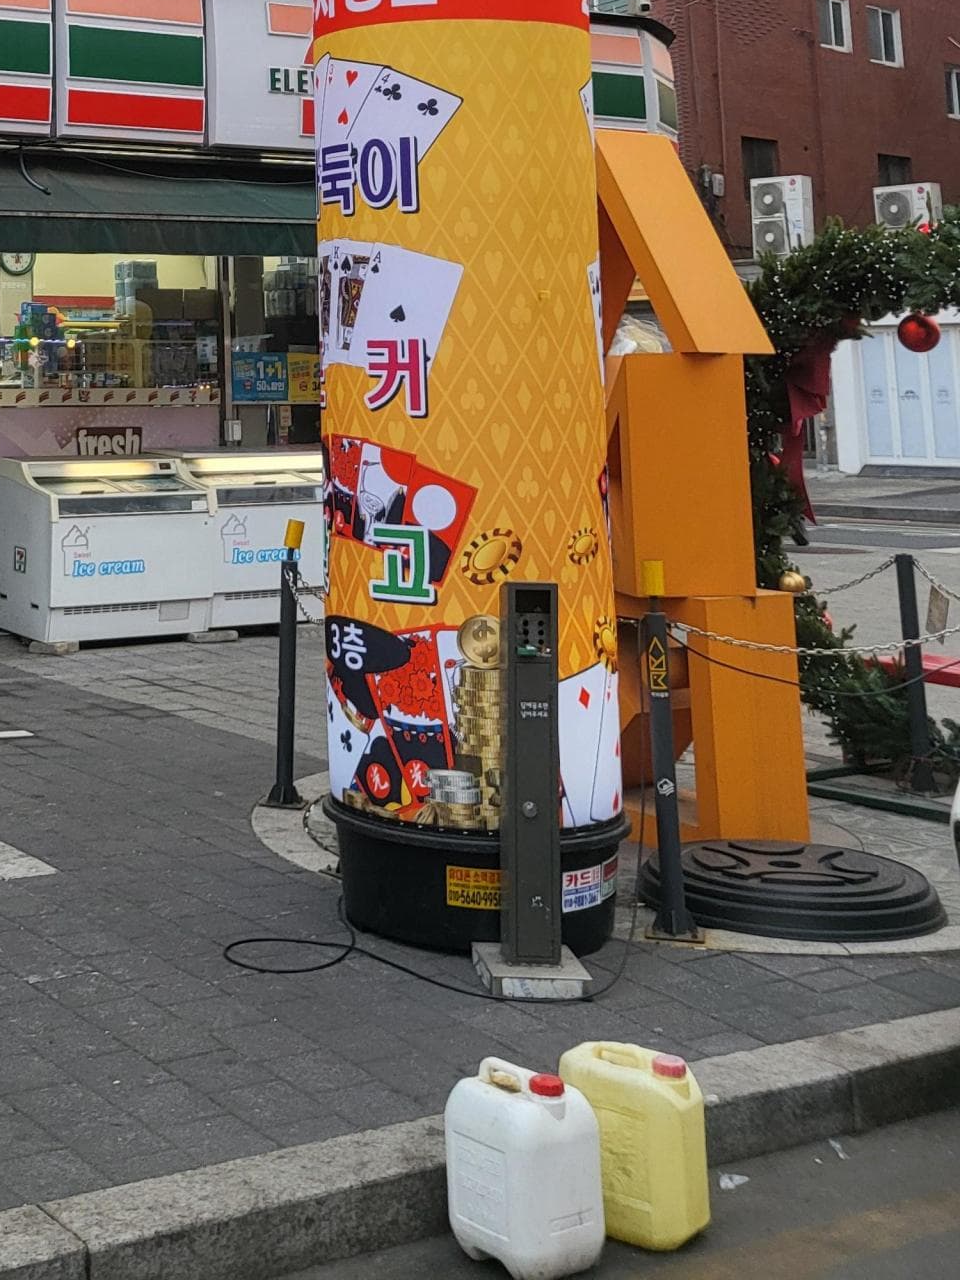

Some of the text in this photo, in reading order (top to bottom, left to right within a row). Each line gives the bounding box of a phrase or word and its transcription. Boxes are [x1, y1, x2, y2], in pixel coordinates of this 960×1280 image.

[270, 68, 314, 93] ELE
[318, 136, 417, 212] 둑이
[78, 428, 140, 455] fresh
[73, 558, 145, 577] Ice cream
[232, 547, 253, 564] Ice
[330, 622, 367, 670] 3층
